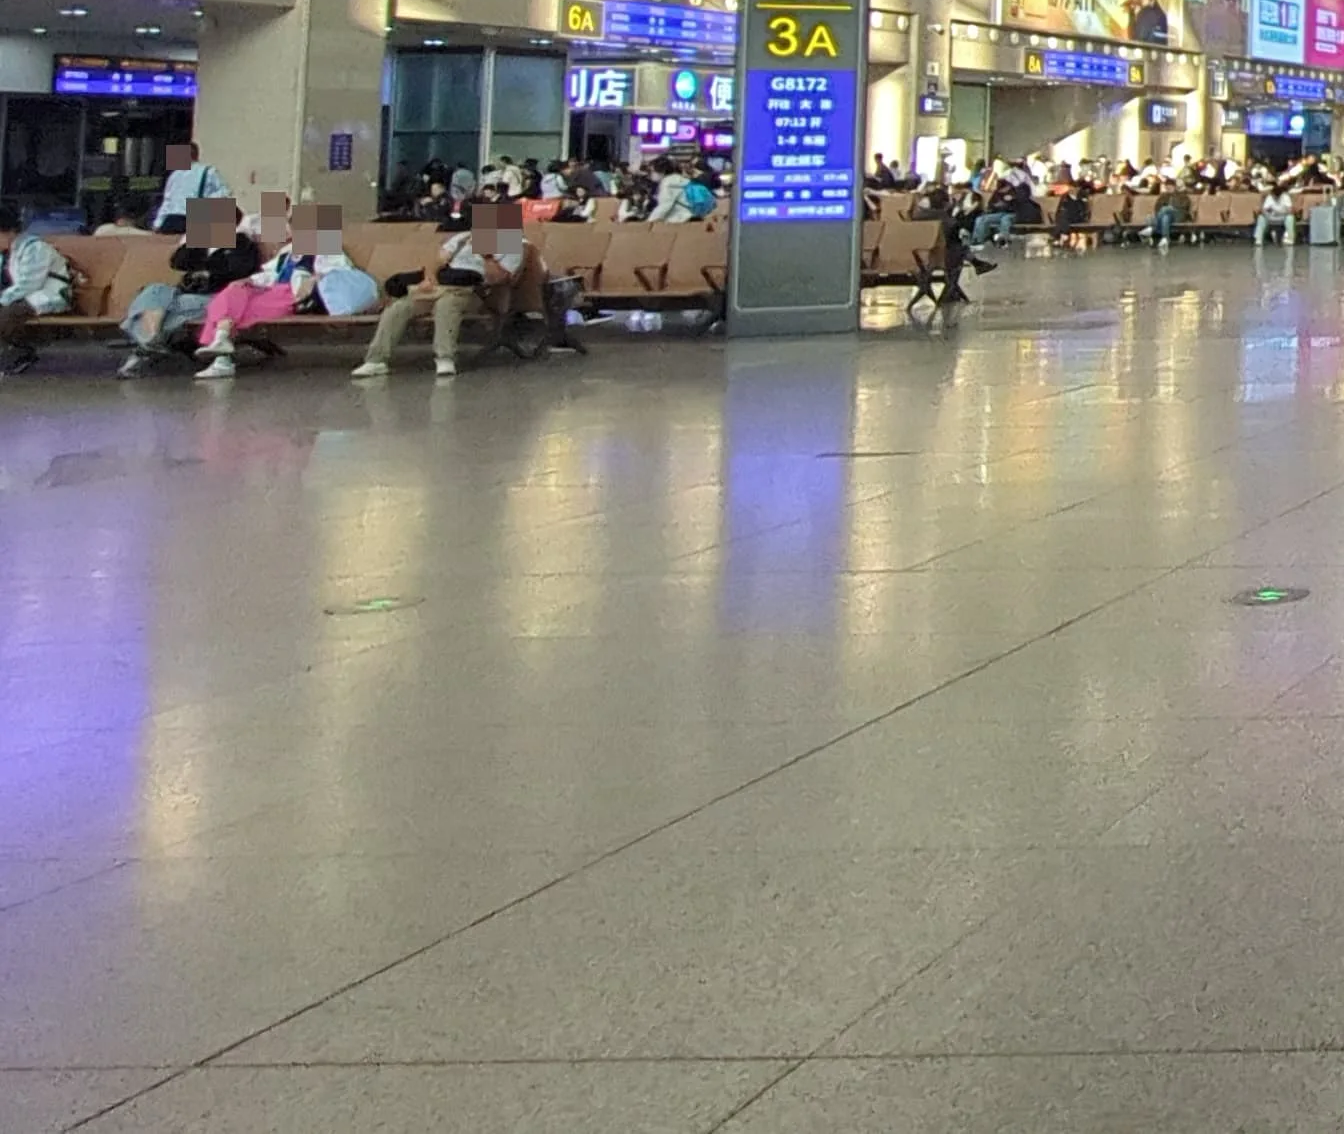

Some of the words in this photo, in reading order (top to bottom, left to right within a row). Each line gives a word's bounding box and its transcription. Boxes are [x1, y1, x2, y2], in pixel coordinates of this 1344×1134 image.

[568, 5, 595, 32] 6A
[767, 17, 838, 58] 3A
[771, 77, 828, 92] G8172
